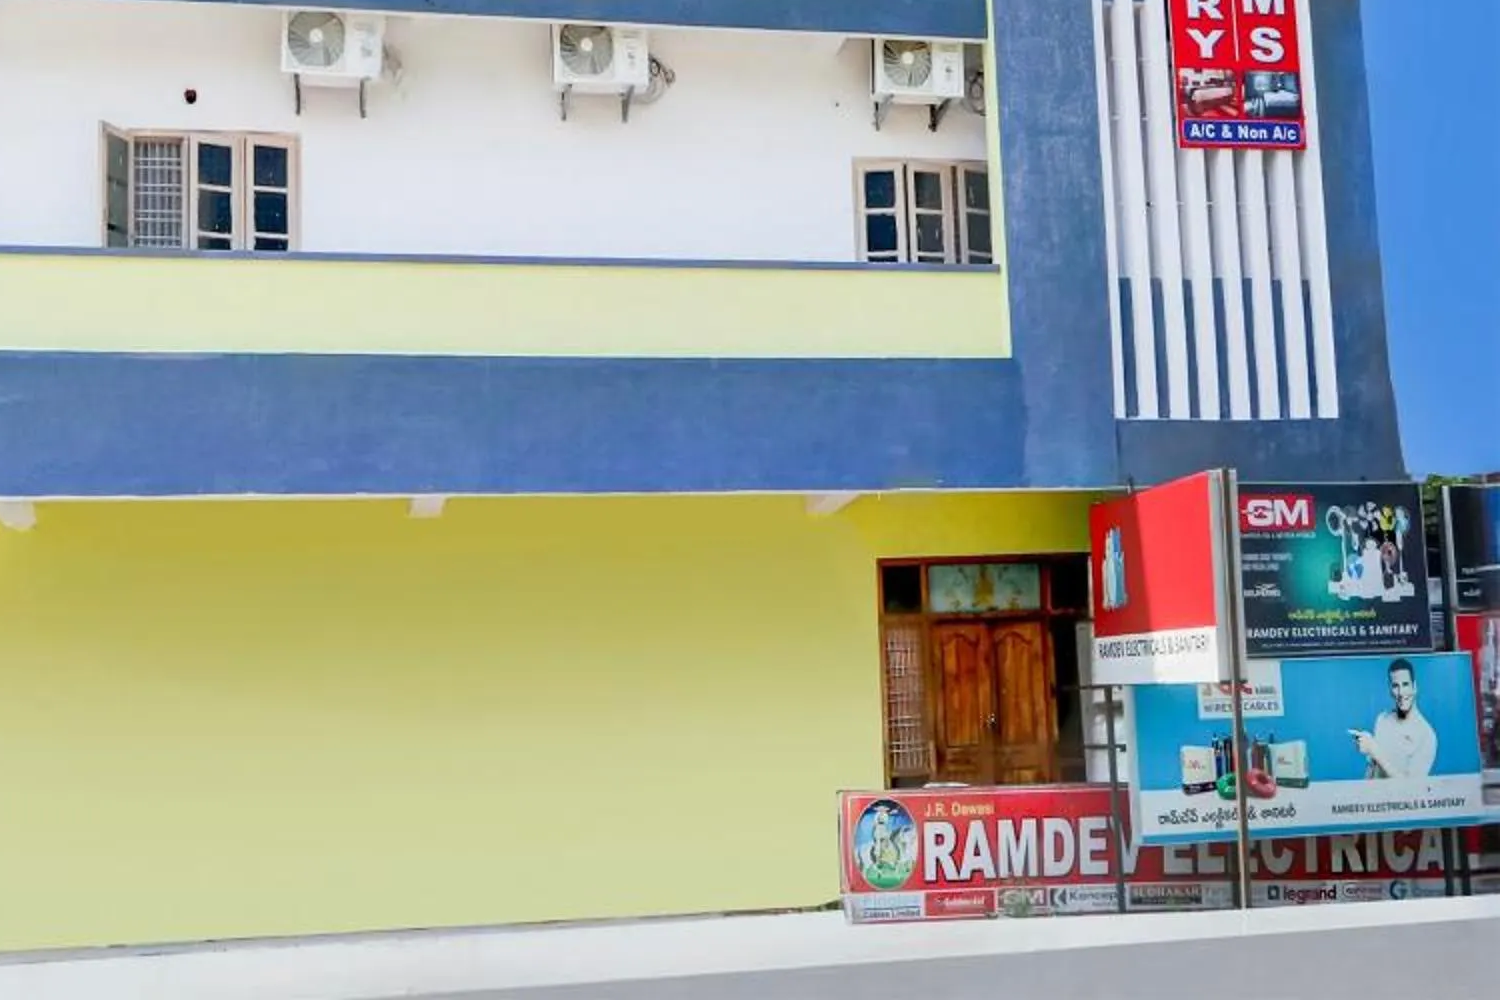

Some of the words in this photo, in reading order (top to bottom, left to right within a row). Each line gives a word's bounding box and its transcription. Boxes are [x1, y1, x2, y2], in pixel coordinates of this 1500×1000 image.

[1189, 123, 1216, 139] A/C
[1221, 123, 1233, 140] &
[1237, 125, 1269, 141] Non
[1246, 627, 1290, 639] RAMDEV
[1291, 625, 1357, 638] ELECTRICALS
[1358, 625, 1367, 636] &
[1368, 623, 1419, 636] SANITARY
[924, 802, 949, 817] J.R.
[923, 816, 1141, 882] RAMDEV
[1283, 884, 1337, 904] legrand
